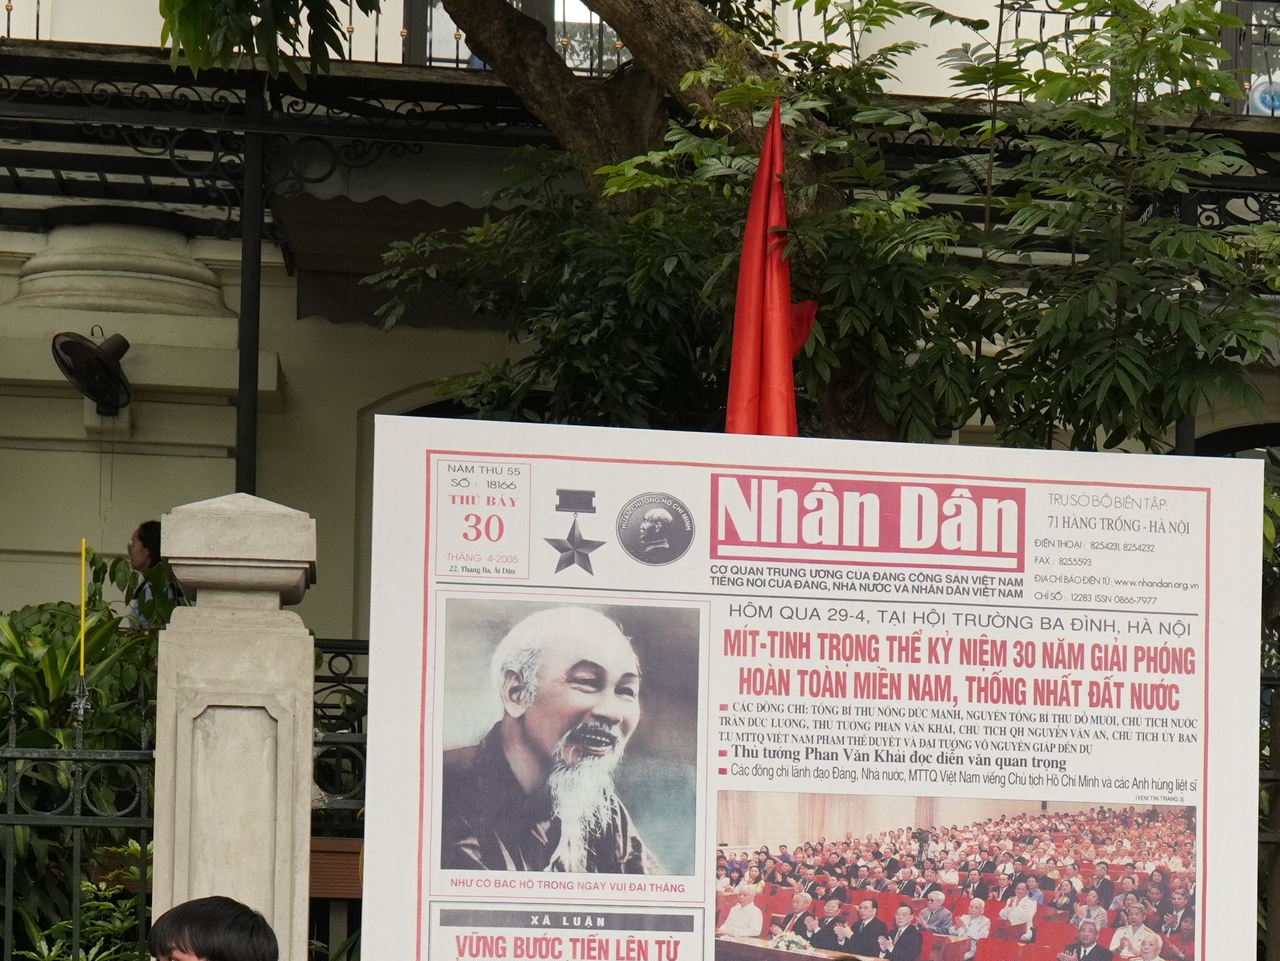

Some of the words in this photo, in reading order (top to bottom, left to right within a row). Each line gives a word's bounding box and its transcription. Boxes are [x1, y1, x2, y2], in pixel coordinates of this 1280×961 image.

[448, 464, 474, 473] NĂM
[507, 467, 520, 475] 55
[486, 480, 516, 490] 18166
[462, 512, 504, 543] 30
[717, 476, 880, 548] Nhân
[900, 485, 1018, 554] Dân
[1048, 515, 1058, 528] 71
[1062, 516, 1096, 529] HÀNG
[1149, 518, 1166, 533] HÀ
[1168, 519, 1189, 536] NỘI
[487, 554, 518, 563] 4-2005
[1034, 556, 1050, 564] FAX
[1058, 557, 1091, 566] 8255593
[729, 601, 772, 618] HÔM
[780, 606, 821, 620] QUA
[827, 608, 869, 624] 29-4,
[877, 610, 905, 626] TẠI
[913, 609, 948, 631] HỘI
[952, 611, 1032, 629] TRƯỜNG
[1040, 616, 1064, 630] BA
[1070, 615, 1120, 638] ĐÌNH,
[1128, 618, 1152, 634] HÀ
[1159, 619, 1190, 638] NỘI
[724, 624, 810, 659] MÍT-TINH
[816, 632, 880, 667] TRỌNG
[886, 630, 922, 663] THỂ
[928, 631, 953, 664] KỶ
[959, 633, 1007, 672] NIỆM
[1012, 640, 1036, 668] 30
[1042, 637, 1084, 670] NĂM
[1090, 638, 1127, 672] GIẢI
[1134, 641, 1195, 674] PHÓNG
[739, 664, 790, 696] HOÀN
[797, 666, 846, 698] TOÀN
[854, 668, 901, 700] MIỀN
[908, 673, 958, 707] NAM,
[965, 672, 1026, 704] THỐNG
[1033, 675, 1082, 706] NHẤT
[1088, 676, 1124, 708] ĐẤT
[1130, 679, 1179, 711] NƯỚC
[562, 915, 606, 928] LUẬN
[455, 931, 506, 958] VỮNG
[513, 933, 562, 959] BƯỚC
[569, 934, 609, 961] TIẾN
[616, 935, 648, 961] LÊN
[654, 936, 680, 961] TỪ
